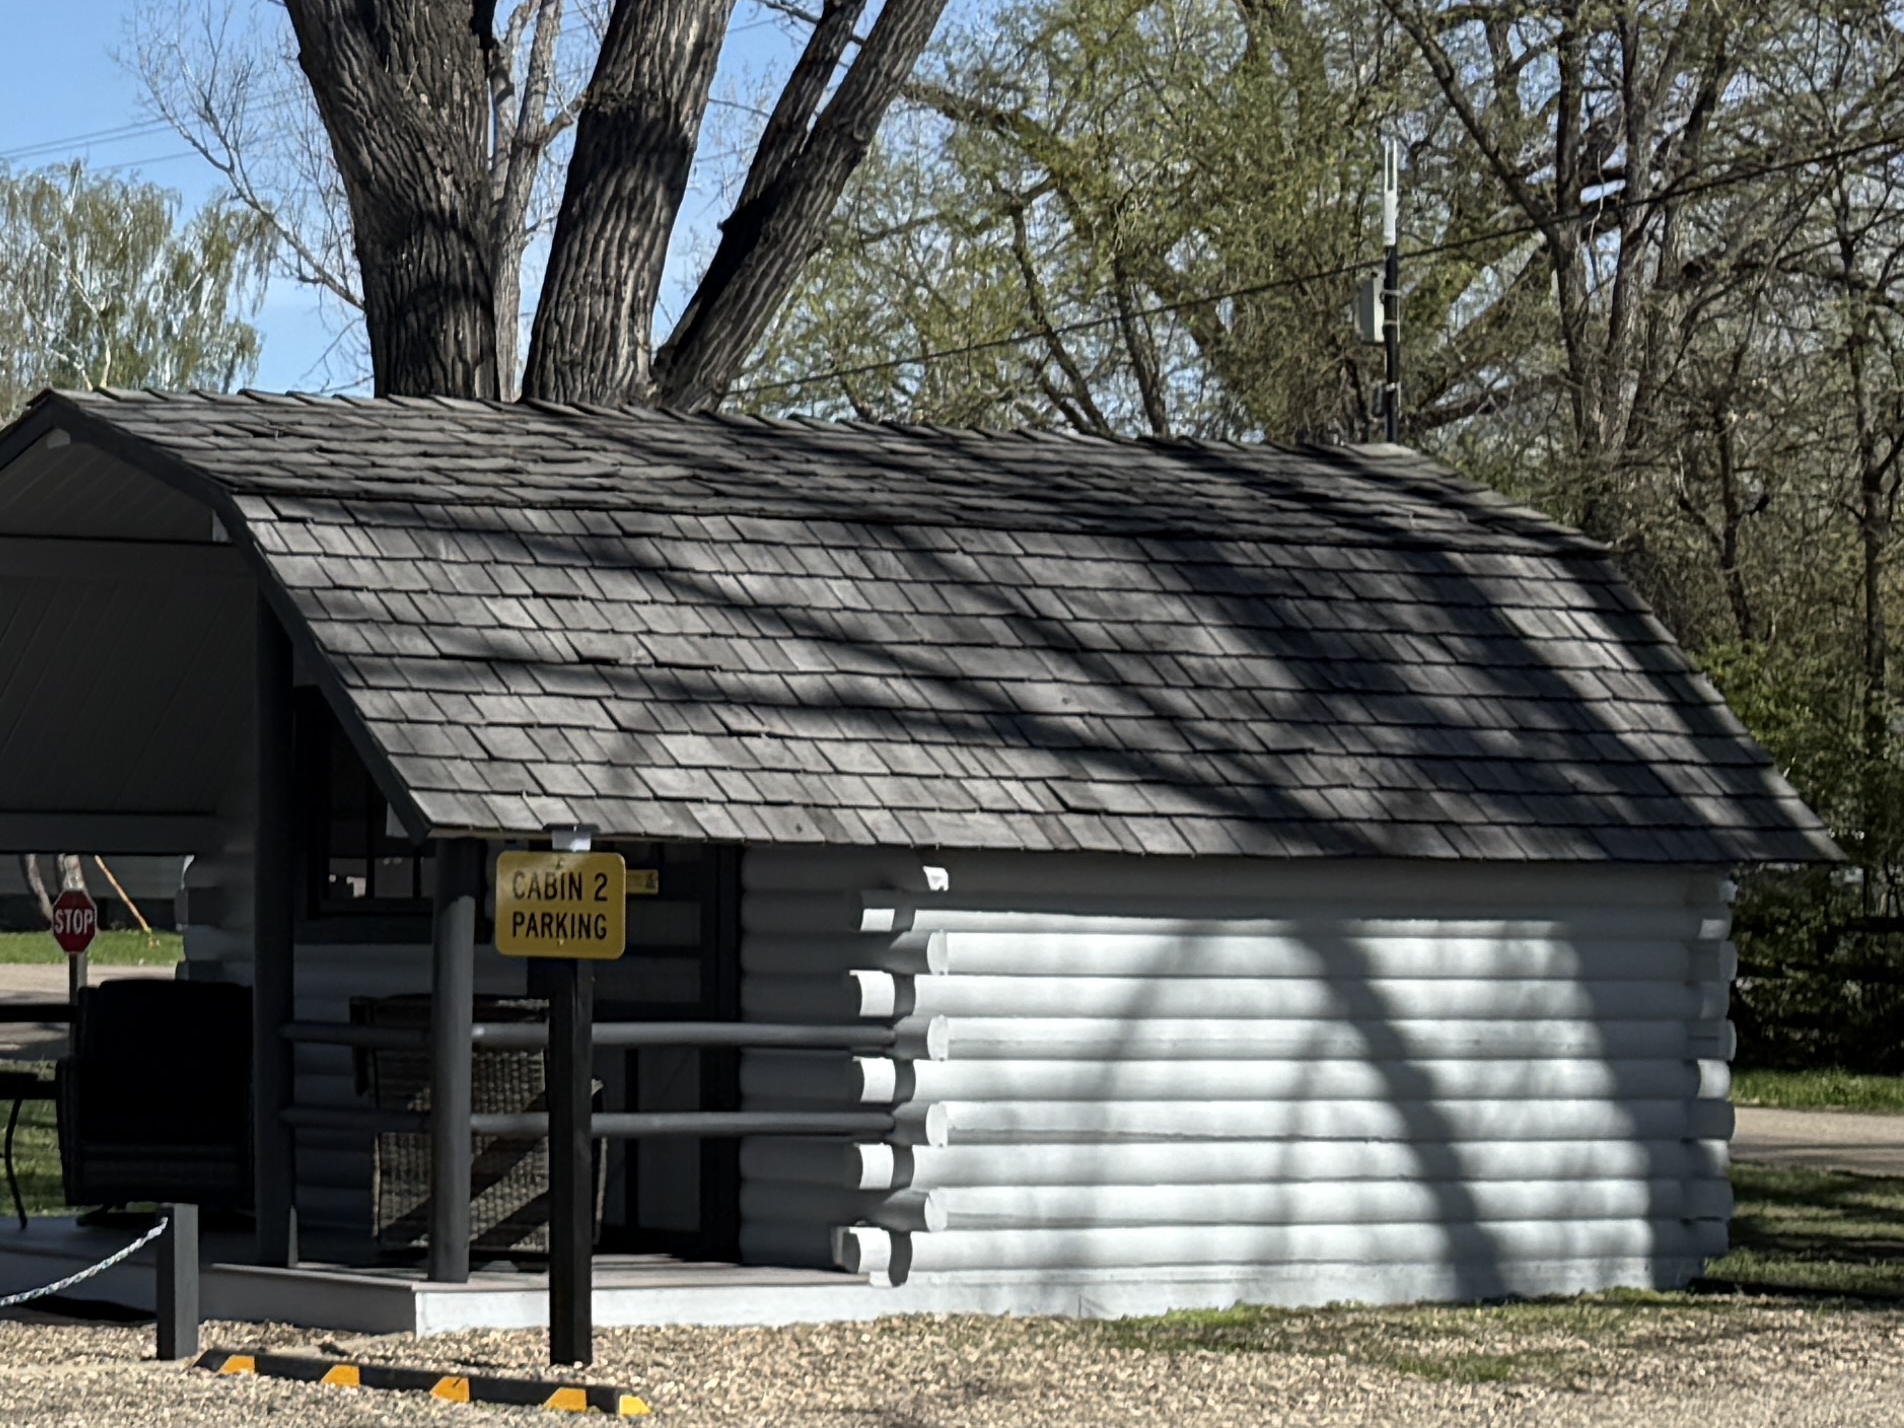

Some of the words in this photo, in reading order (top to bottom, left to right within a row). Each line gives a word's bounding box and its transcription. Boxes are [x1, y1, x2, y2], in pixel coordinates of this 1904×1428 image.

[512, 869, 582, 902] CABIN
[594, 872, 608, 902] 2
[54, 908, 94, 935] STOP
[512, 911, 607, 941] PARKING
